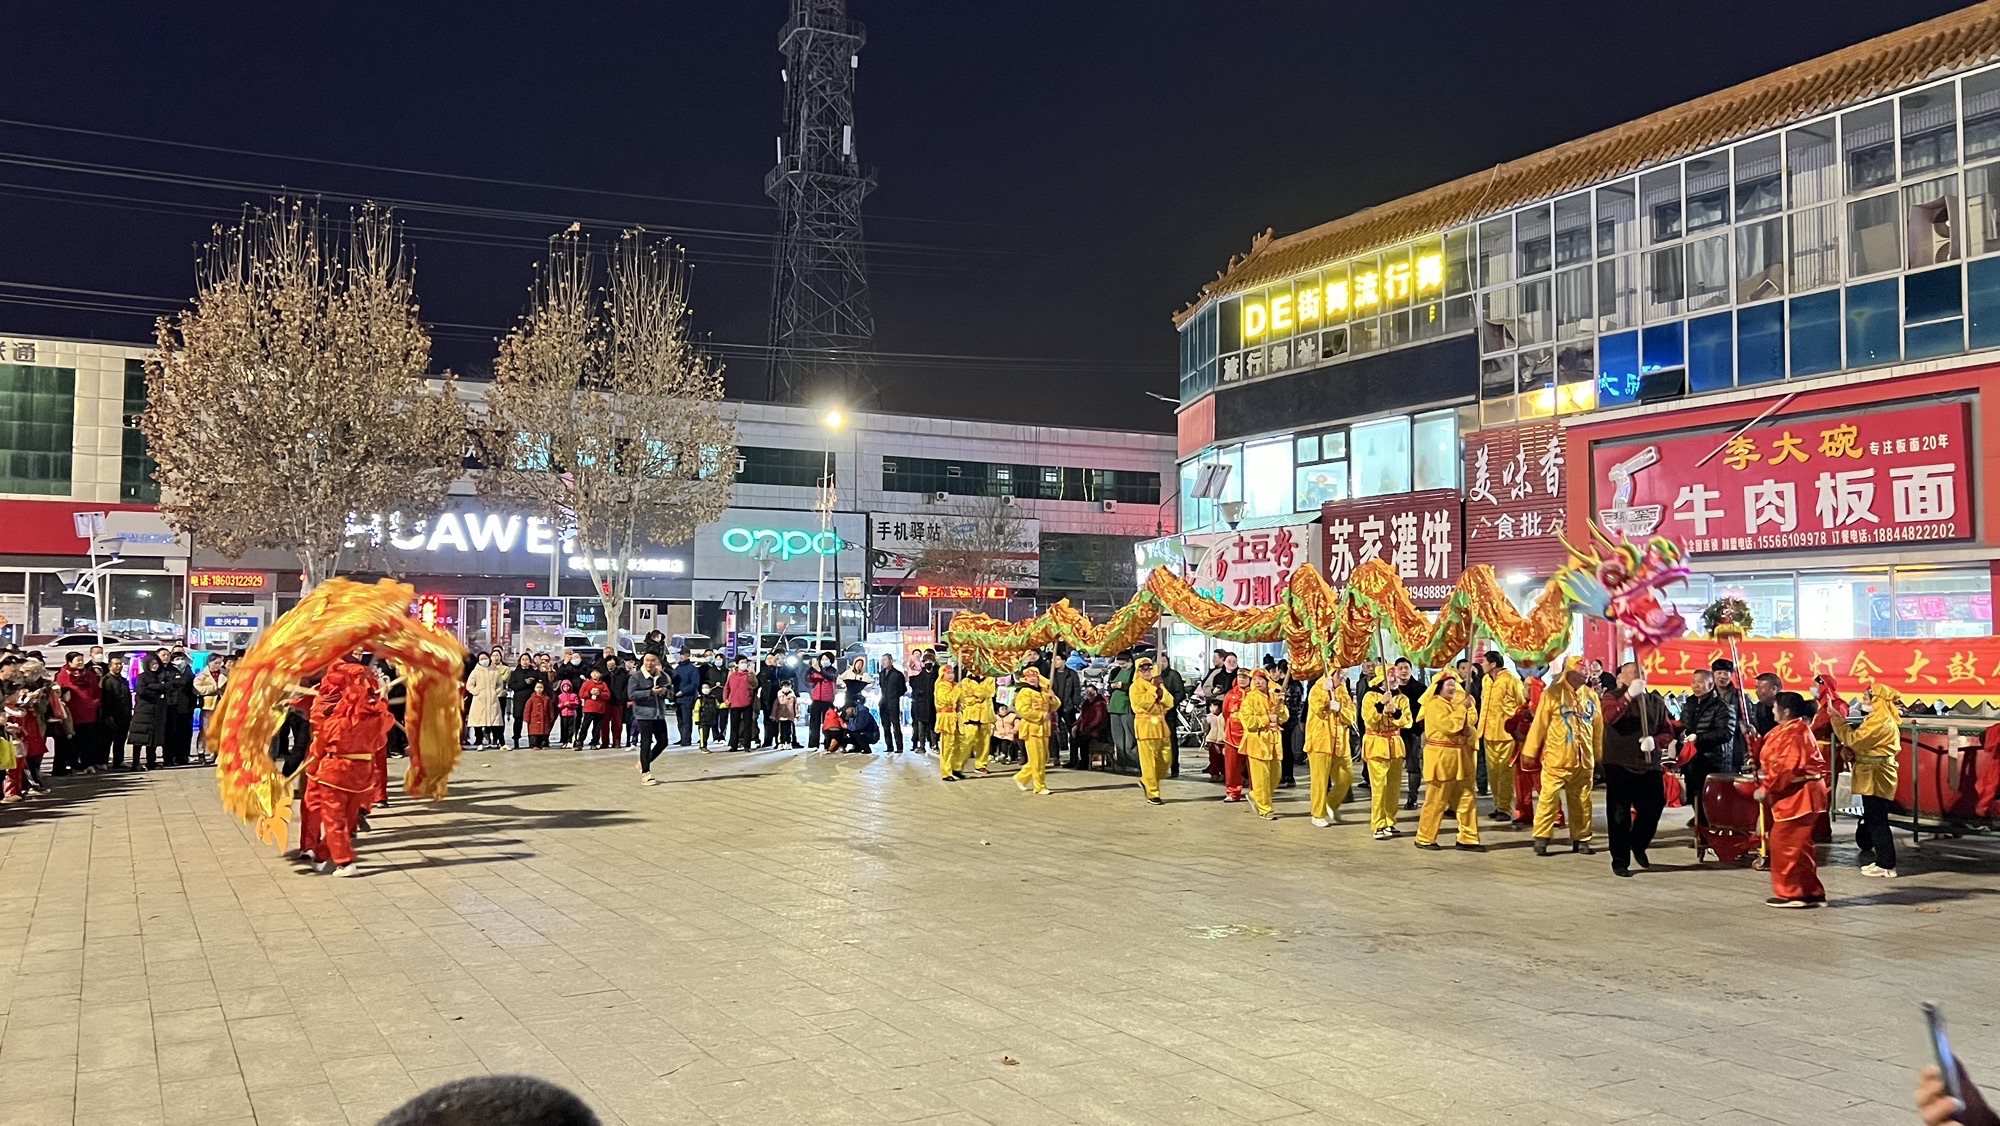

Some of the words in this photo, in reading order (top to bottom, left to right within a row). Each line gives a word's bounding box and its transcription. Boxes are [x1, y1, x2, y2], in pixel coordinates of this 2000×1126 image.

[0, 341, 36, 362] 通
[1223, 338, 1316, 382] 流行舞社
[1722, 423, 1864, 471] 李大碗
[1869, 433, 1949, 456] 专注板面20年
[1469, 435, 1565, 505] 美味香
[1673, 463, 1956, 536] 牛肉板面
[877, 521, 942, 541] 手机驿站
[1231, 527, 1299, 568] 土豆粉
[1329, 508, 1452, 582] 苏家灌饼
[1688, 537, 1719, 552] 全国连锁
[1904, 649, 2000, 685] 大鼓
